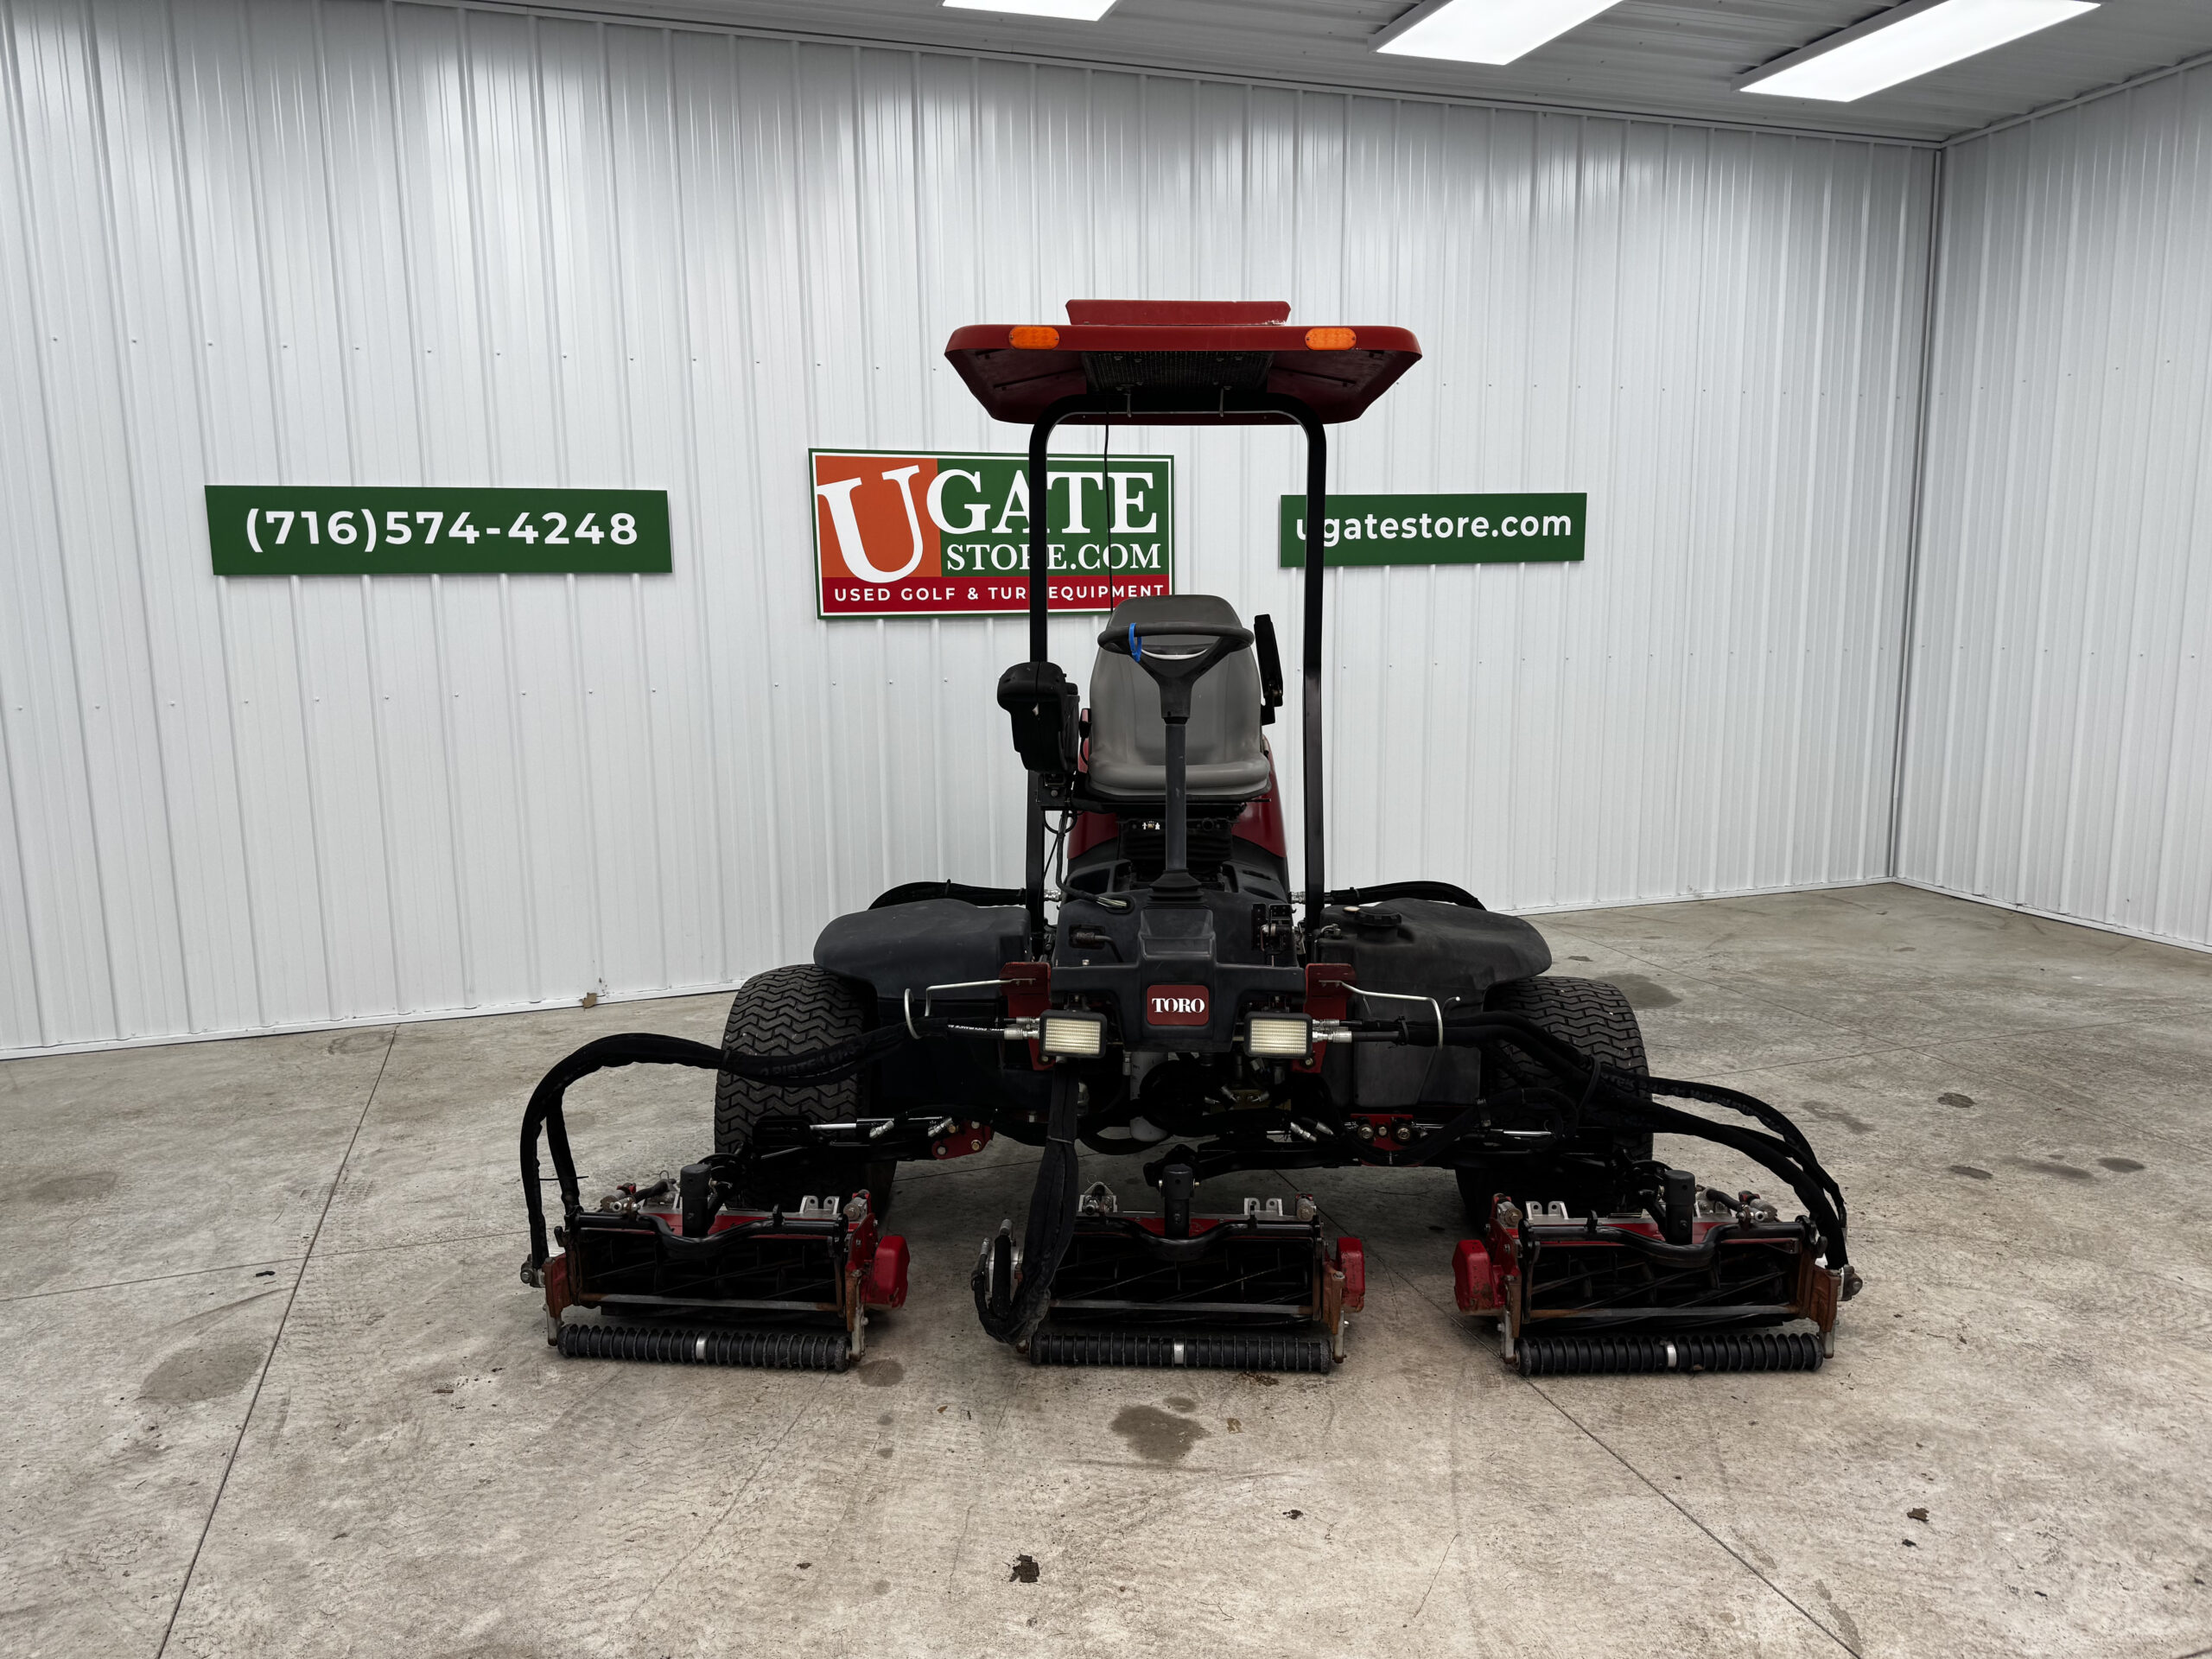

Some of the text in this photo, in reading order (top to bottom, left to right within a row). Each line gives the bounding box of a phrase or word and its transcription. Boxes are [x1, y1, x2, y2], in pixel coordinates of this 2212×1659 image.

[247, 509, 637, 552] (716)574-4248
[835, 585, 1165, 601] USED GOLF & TUR EQUIPMENT
[1152, 998, 1205, 1013] TORO
